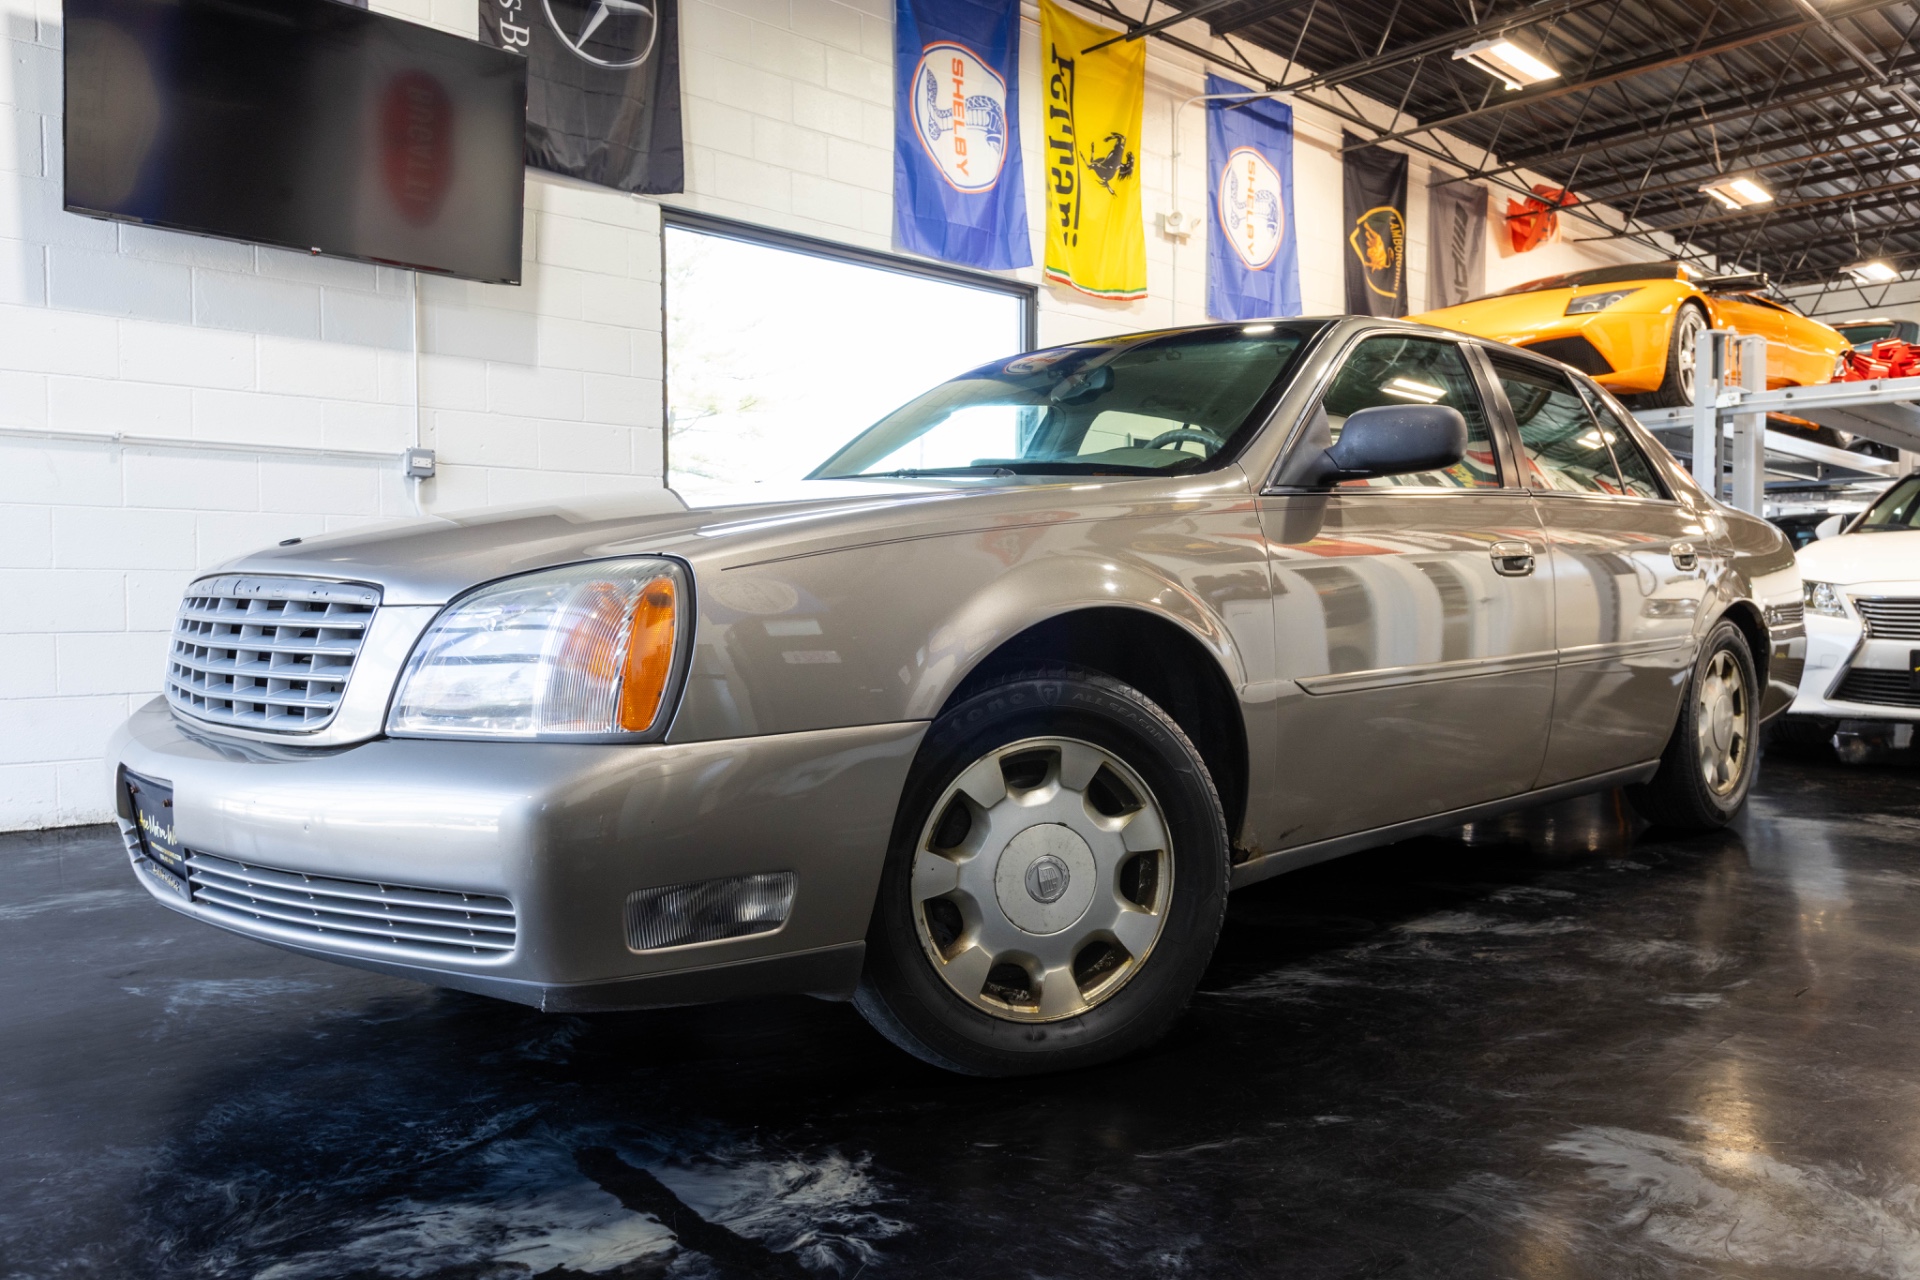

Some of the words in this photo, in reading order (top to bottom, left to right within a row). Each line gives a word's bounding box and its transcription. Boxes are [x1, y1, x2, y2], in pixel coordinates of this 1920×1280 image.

[951, 57, 970, 177] SHELBY
[1048, 42, 1082, 248] Ferrari
[1246, 159, 1256, 256] SHELBY
